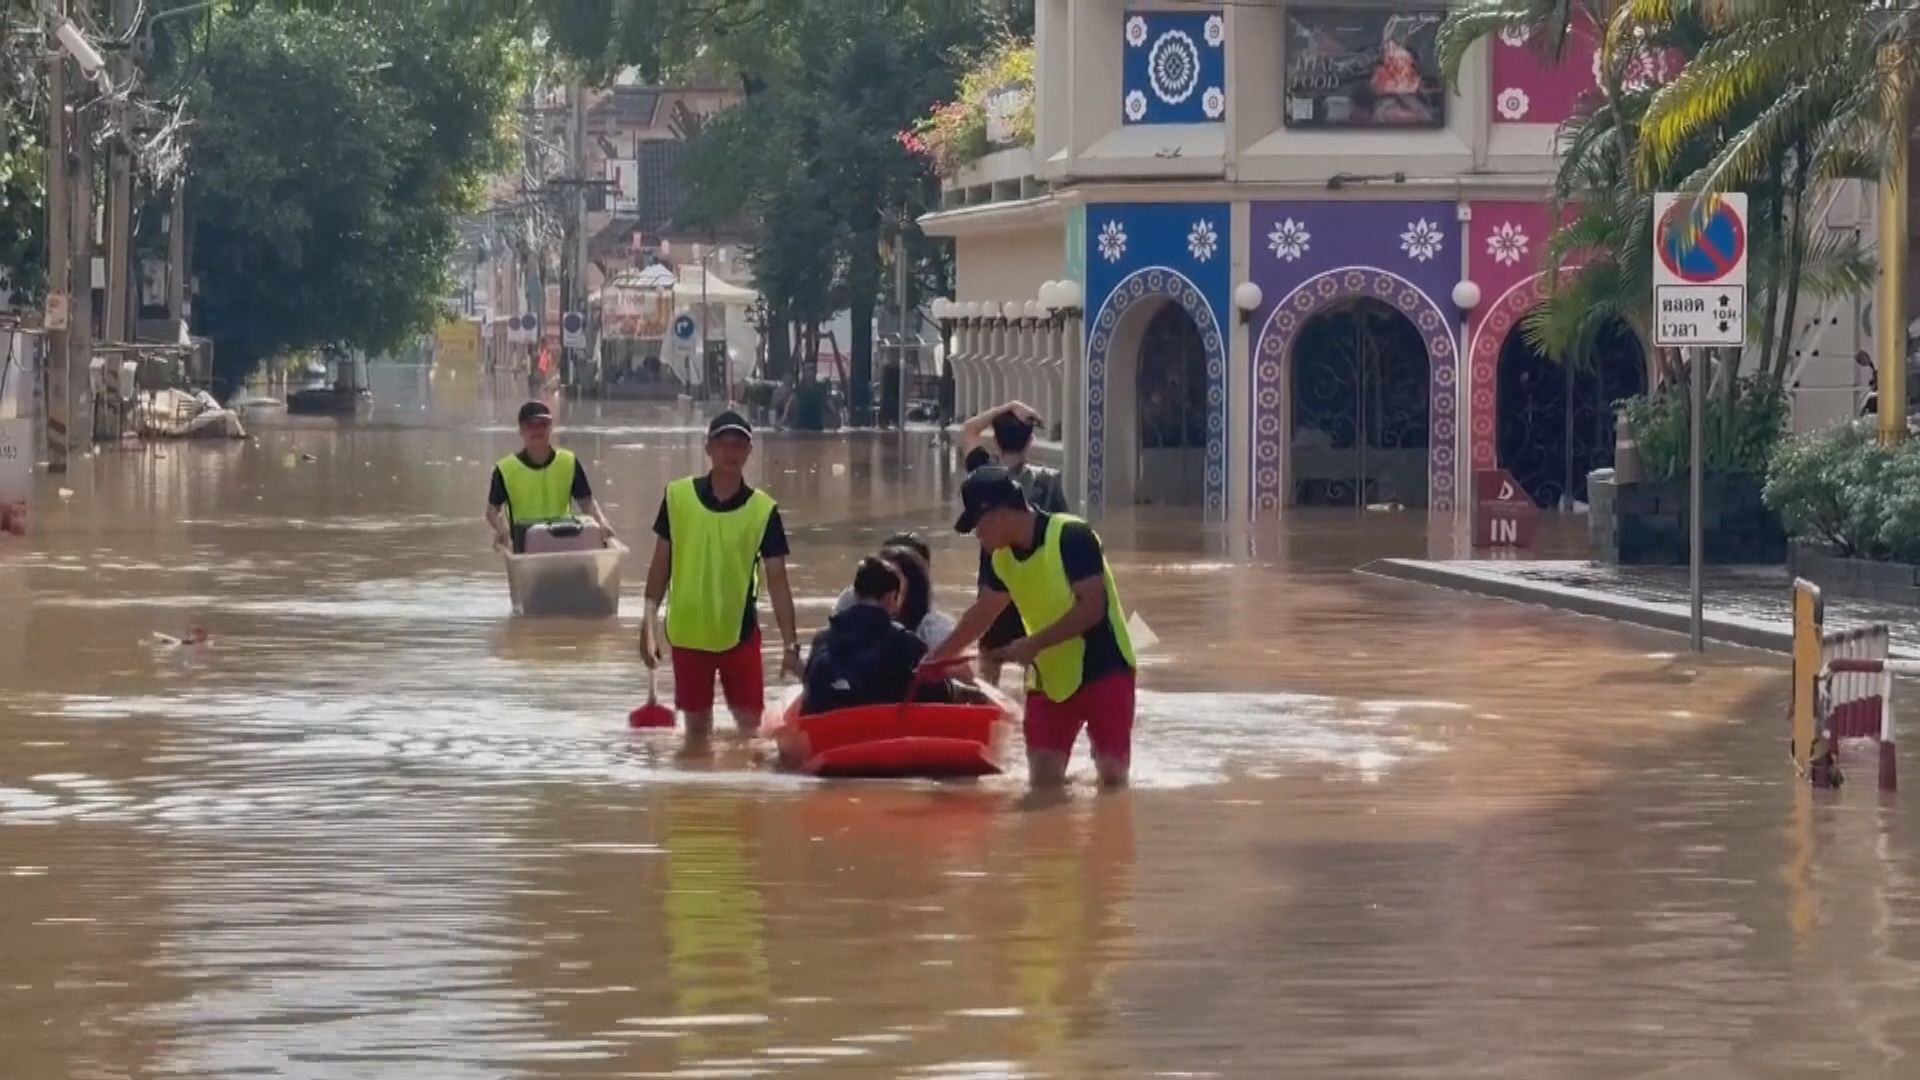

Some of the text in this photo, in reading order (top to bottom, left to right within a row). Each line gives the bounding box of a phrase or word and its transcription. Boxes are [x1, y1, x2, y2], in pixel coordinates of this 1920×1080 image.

[1662, 298, 1705, 312] ตลอด
[1662, 322, 1698, 337] เวลา
[1490, 518, 1517, 542] IN
